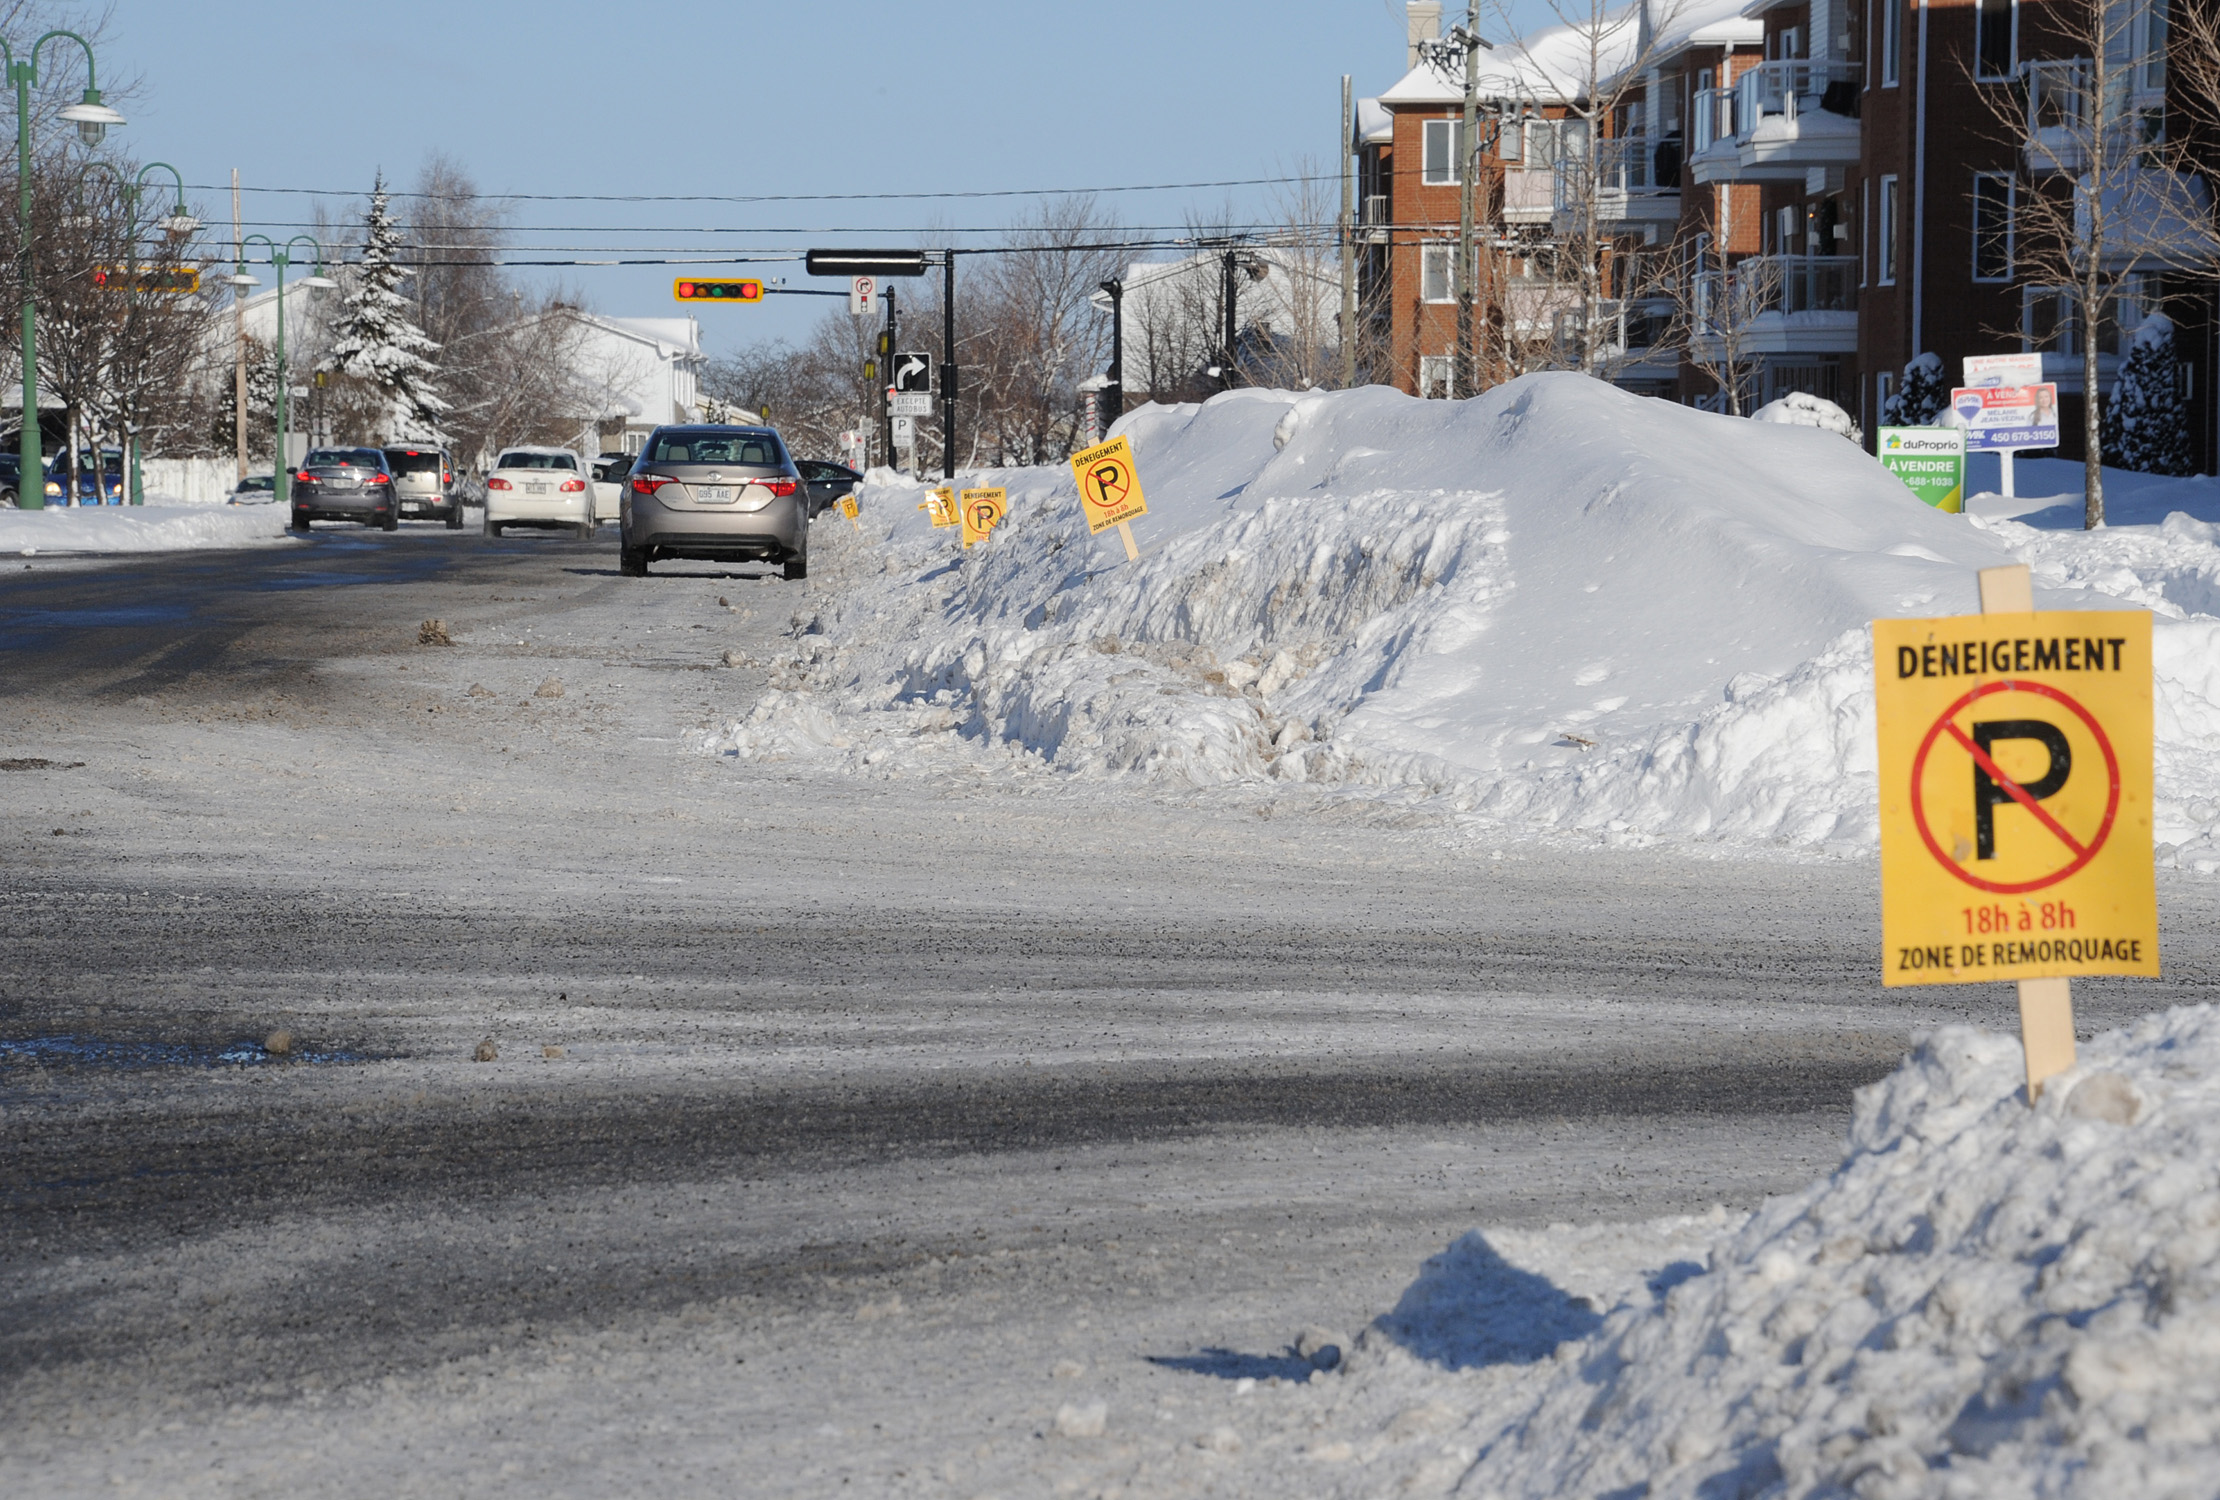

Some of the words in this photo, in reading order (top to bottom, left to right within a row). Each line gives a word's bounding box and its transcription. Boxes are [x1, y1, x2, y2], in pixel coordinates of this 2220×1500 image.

[898, 419, 907, 430] P
[1903, 440, 1959, 451] duProprio
[1991, 432, 2010, 443] 450
[2011, 430, 2056, 442] 678-3150
[1075, 442, 1123, 468] DÉNEIGEMENT
[1889, 458, 1898, 472] À
[1899, 461, 1955, 472] VENDRE
[717, 490, 729, 498] AAE
[1093, 521, 1105, 531] ZONE
[1106, 518, 1112, 526] DE
[1112, 506, 1143, 524] REMORQUAGE
[1104, 509, 1115, 519] 18h
[1121, 504, 1129, 512] 8h
[1897, 634, 2125, 679] DÉNEIGEMENT
[1972, 719, 2072, 861] P
[1962, 904, 2010, 935] 18h
[2017, 902, 2032, 931] à
[2040, 899, 2077, 930] 8h
[1899, 945, 1955, 971] ZONE
[1962, 943, 1988, 967] DE
[1993, 938, 2145, 966] REMORQUAGE
